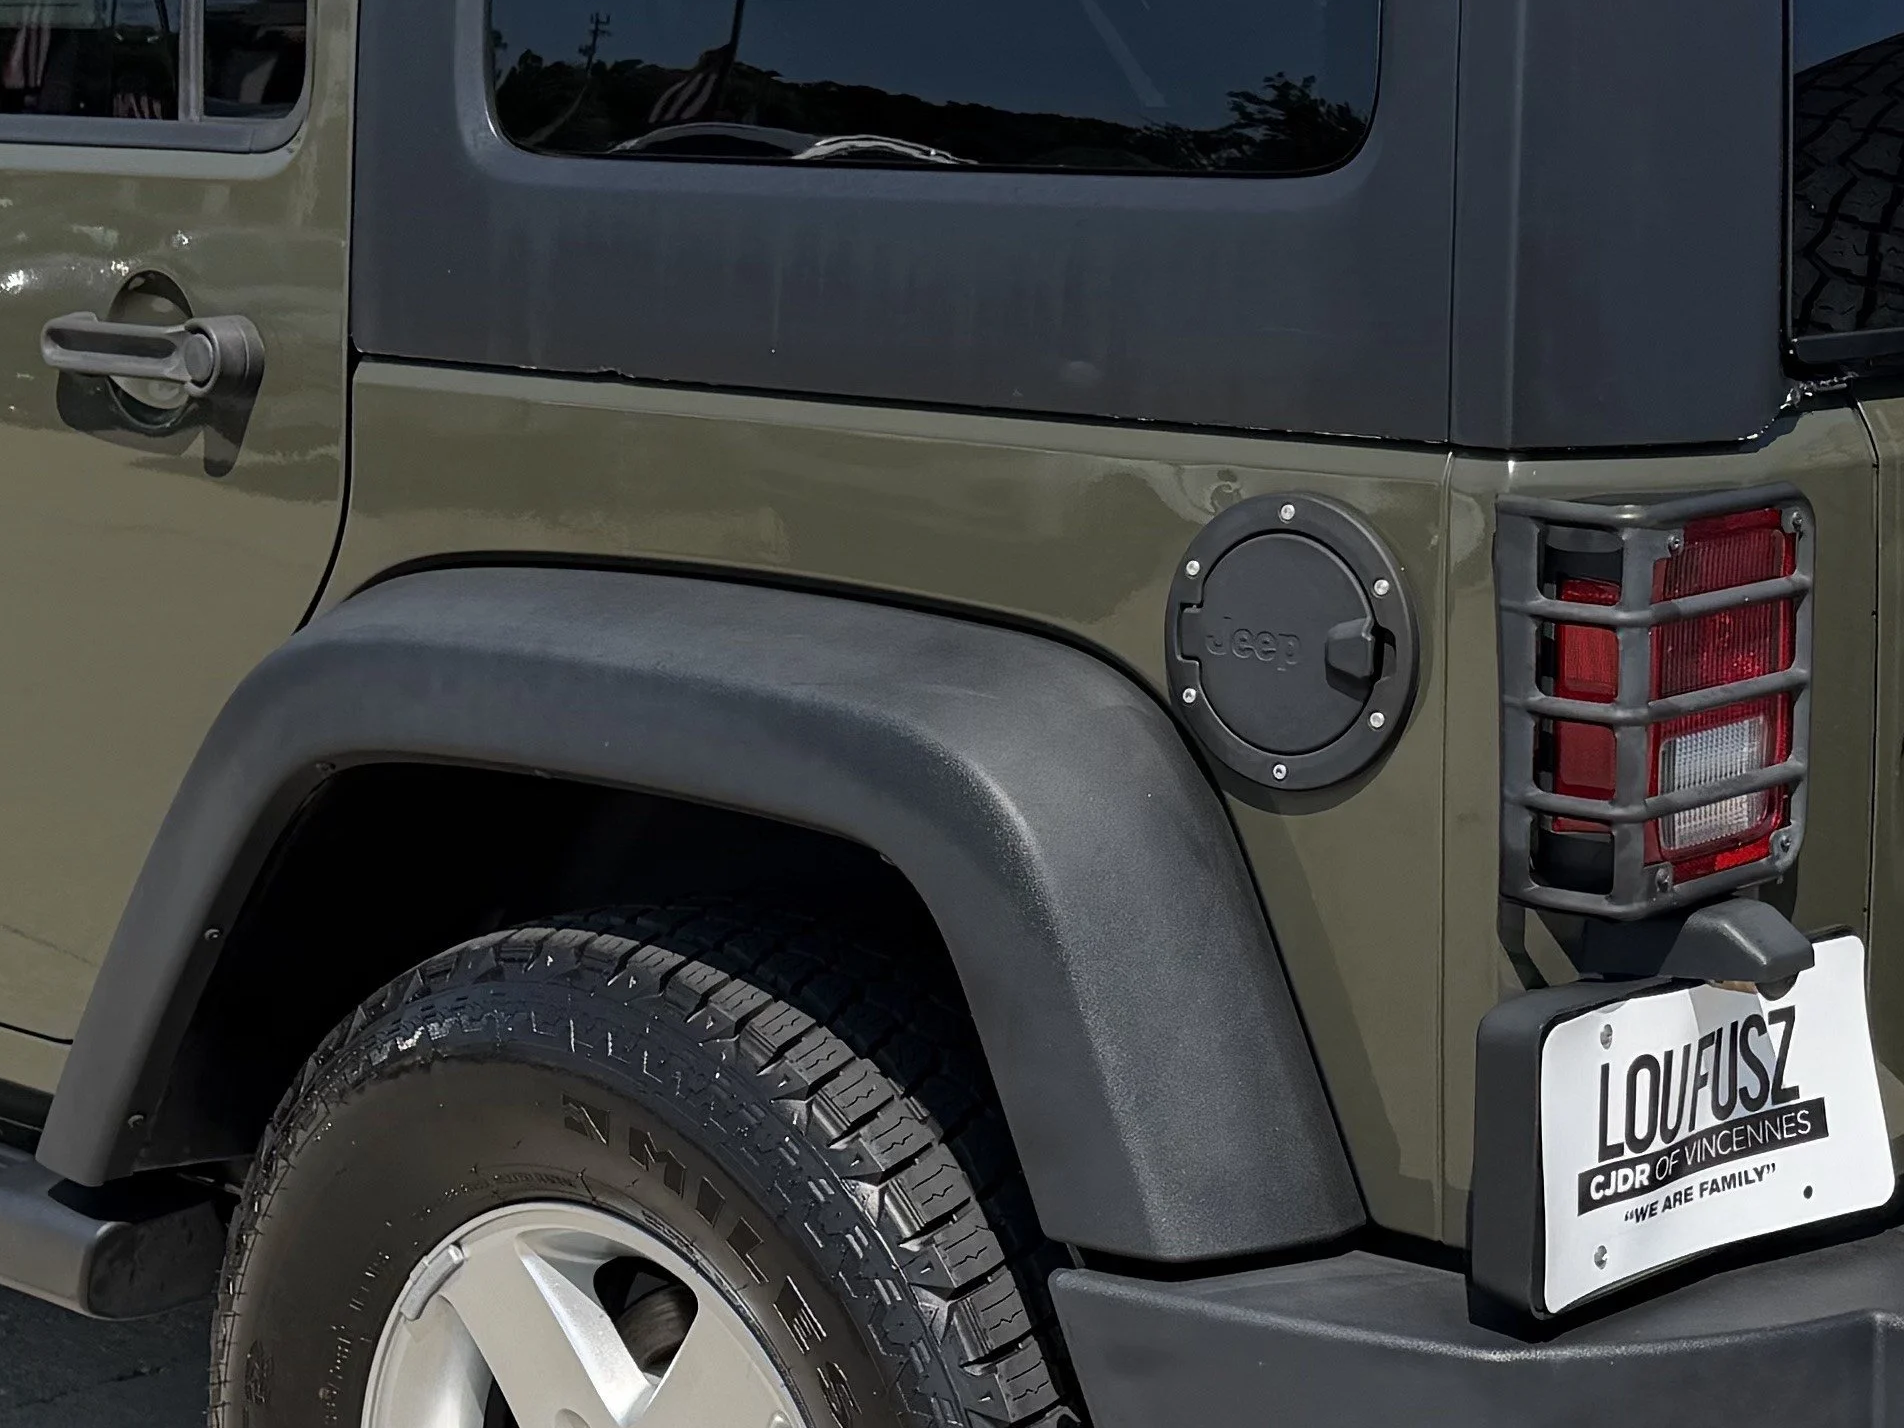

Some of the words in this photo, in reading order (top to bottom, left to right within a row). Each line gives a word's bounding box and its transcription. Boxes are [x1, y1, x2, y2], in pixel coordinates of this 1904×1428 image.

[1204, 616, 1302, 672] Jeep
[1589, 1162, 1651, 1201] CJDR
[1655, 1148, 1681, 1181] OF
[1684, 1109, 1812, 1166] VINCENNES
[1661, 1185, 1694, 1214] ARE
